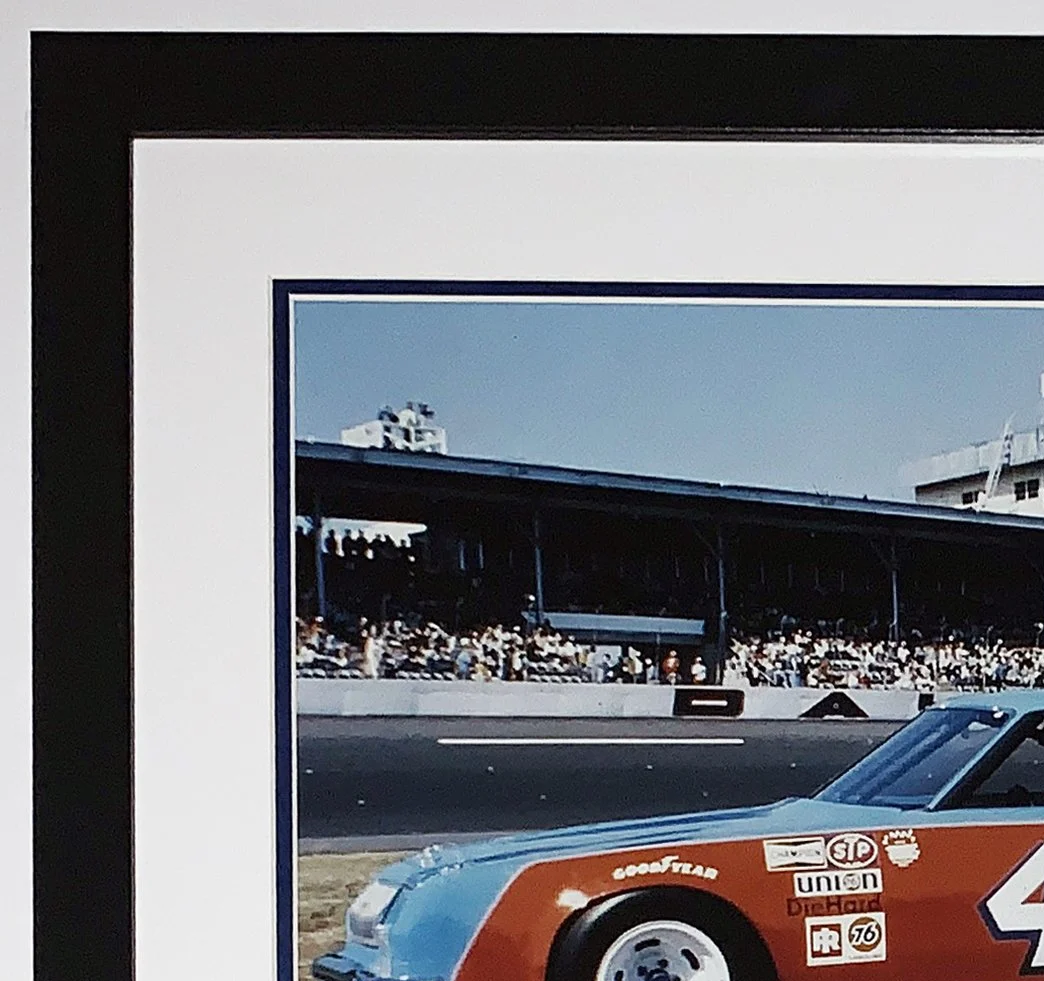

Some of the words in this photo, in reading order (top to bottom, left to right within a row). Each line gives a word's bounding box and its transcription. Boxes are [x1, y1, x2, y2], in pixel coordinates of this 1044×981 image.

[832, 837, 872, 861] STP
[611, 854, 720, 881] GOODYEAR
[786, 894, 883, 917] DieHard
[851, 920, 880, 946] 76
